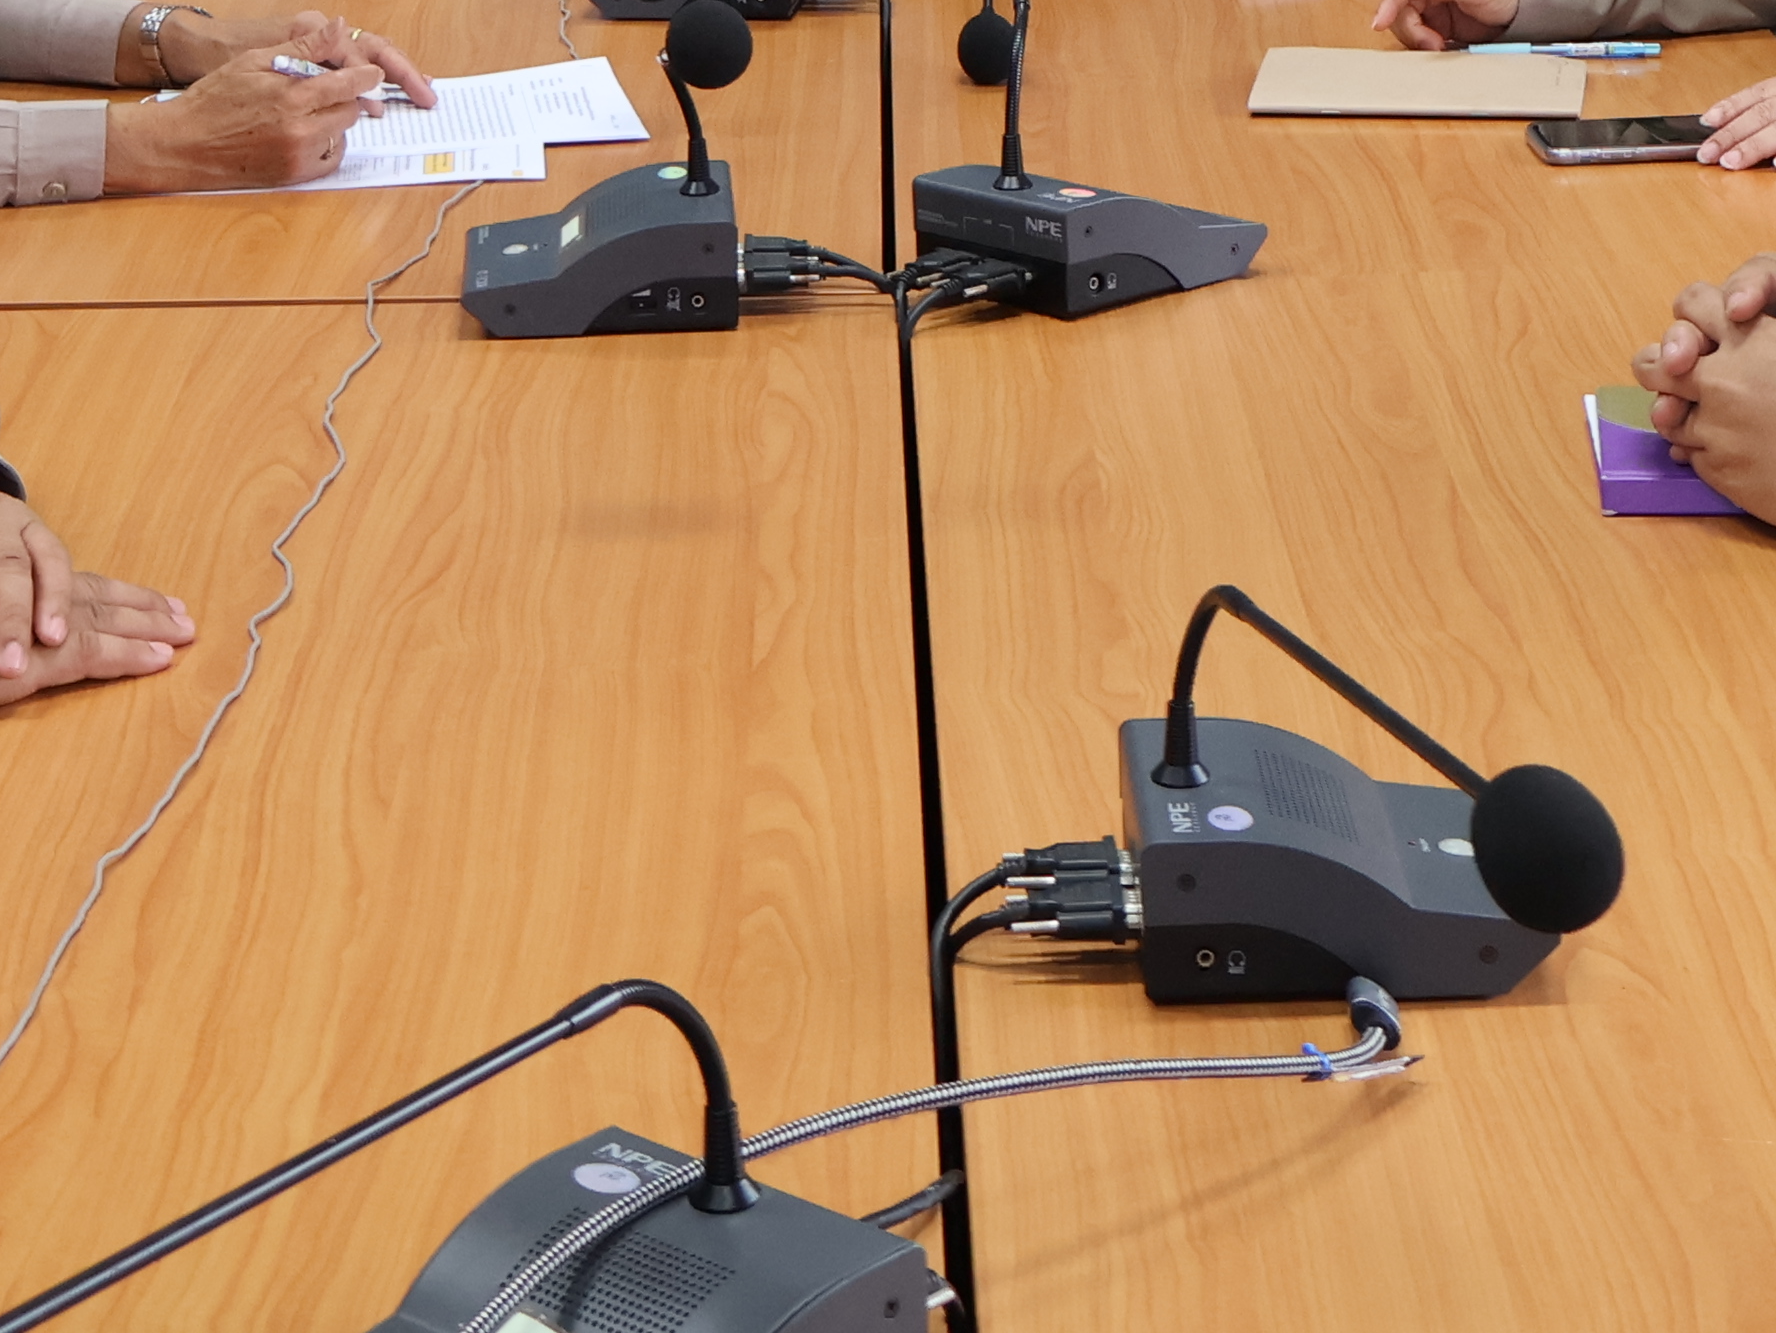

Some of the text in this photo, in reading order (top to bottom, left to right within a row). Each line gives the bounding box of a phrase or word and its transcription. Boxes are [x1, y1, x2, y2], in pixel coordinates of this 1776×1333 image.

[1025, 215, 1064, 239] NPE
[1168, 800, 1193, 834] NPE
[590, 1141, 679, 1179] NPE
